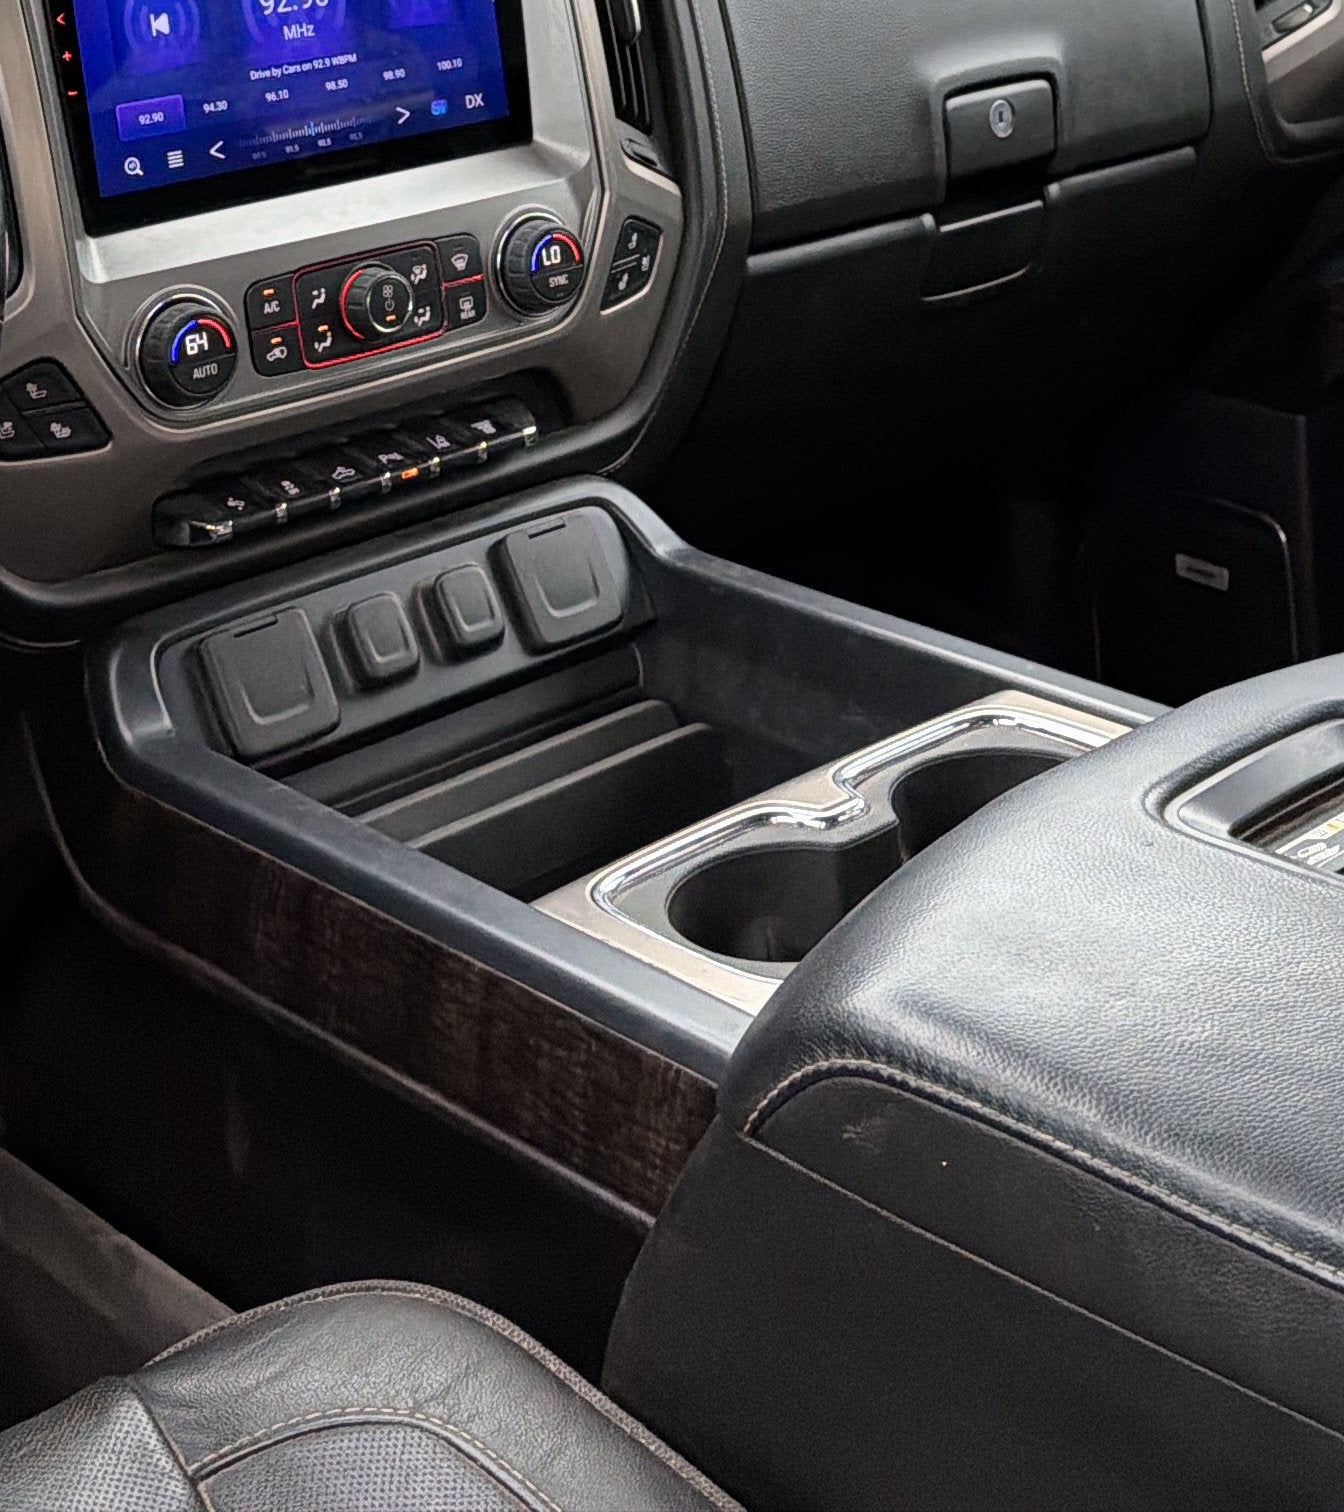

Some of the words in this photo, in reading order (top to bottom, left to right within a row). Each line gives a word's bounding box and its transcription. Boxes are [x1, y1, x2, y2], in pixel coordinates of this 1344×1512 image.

[282, 22, 316, 41] MHz
[249, 69, 271, 81] Drive
[271, 67, 282, 78] by
[282, 64, 302, 75] Cars
[301, 62, 313, 72] on
[312, 57, 331, 70] 92.9
[436, 57, 463, 71] 100.10
[382, 68, 406, 81] 98.90
[325, 78, 349, 91] 98.50
[265, 89, 290, 103] 96.10
[465, 92, 485, 110] DX
[202, 100, 228, 114] 94.30
[138, 112, 164, 126] 92.90
[548, 273, 570, 289] SYNC
[263, 300, 281, 315] A/C
[185, 331, 209, 356] 64
[192, 362, 219, 380] AUTO
